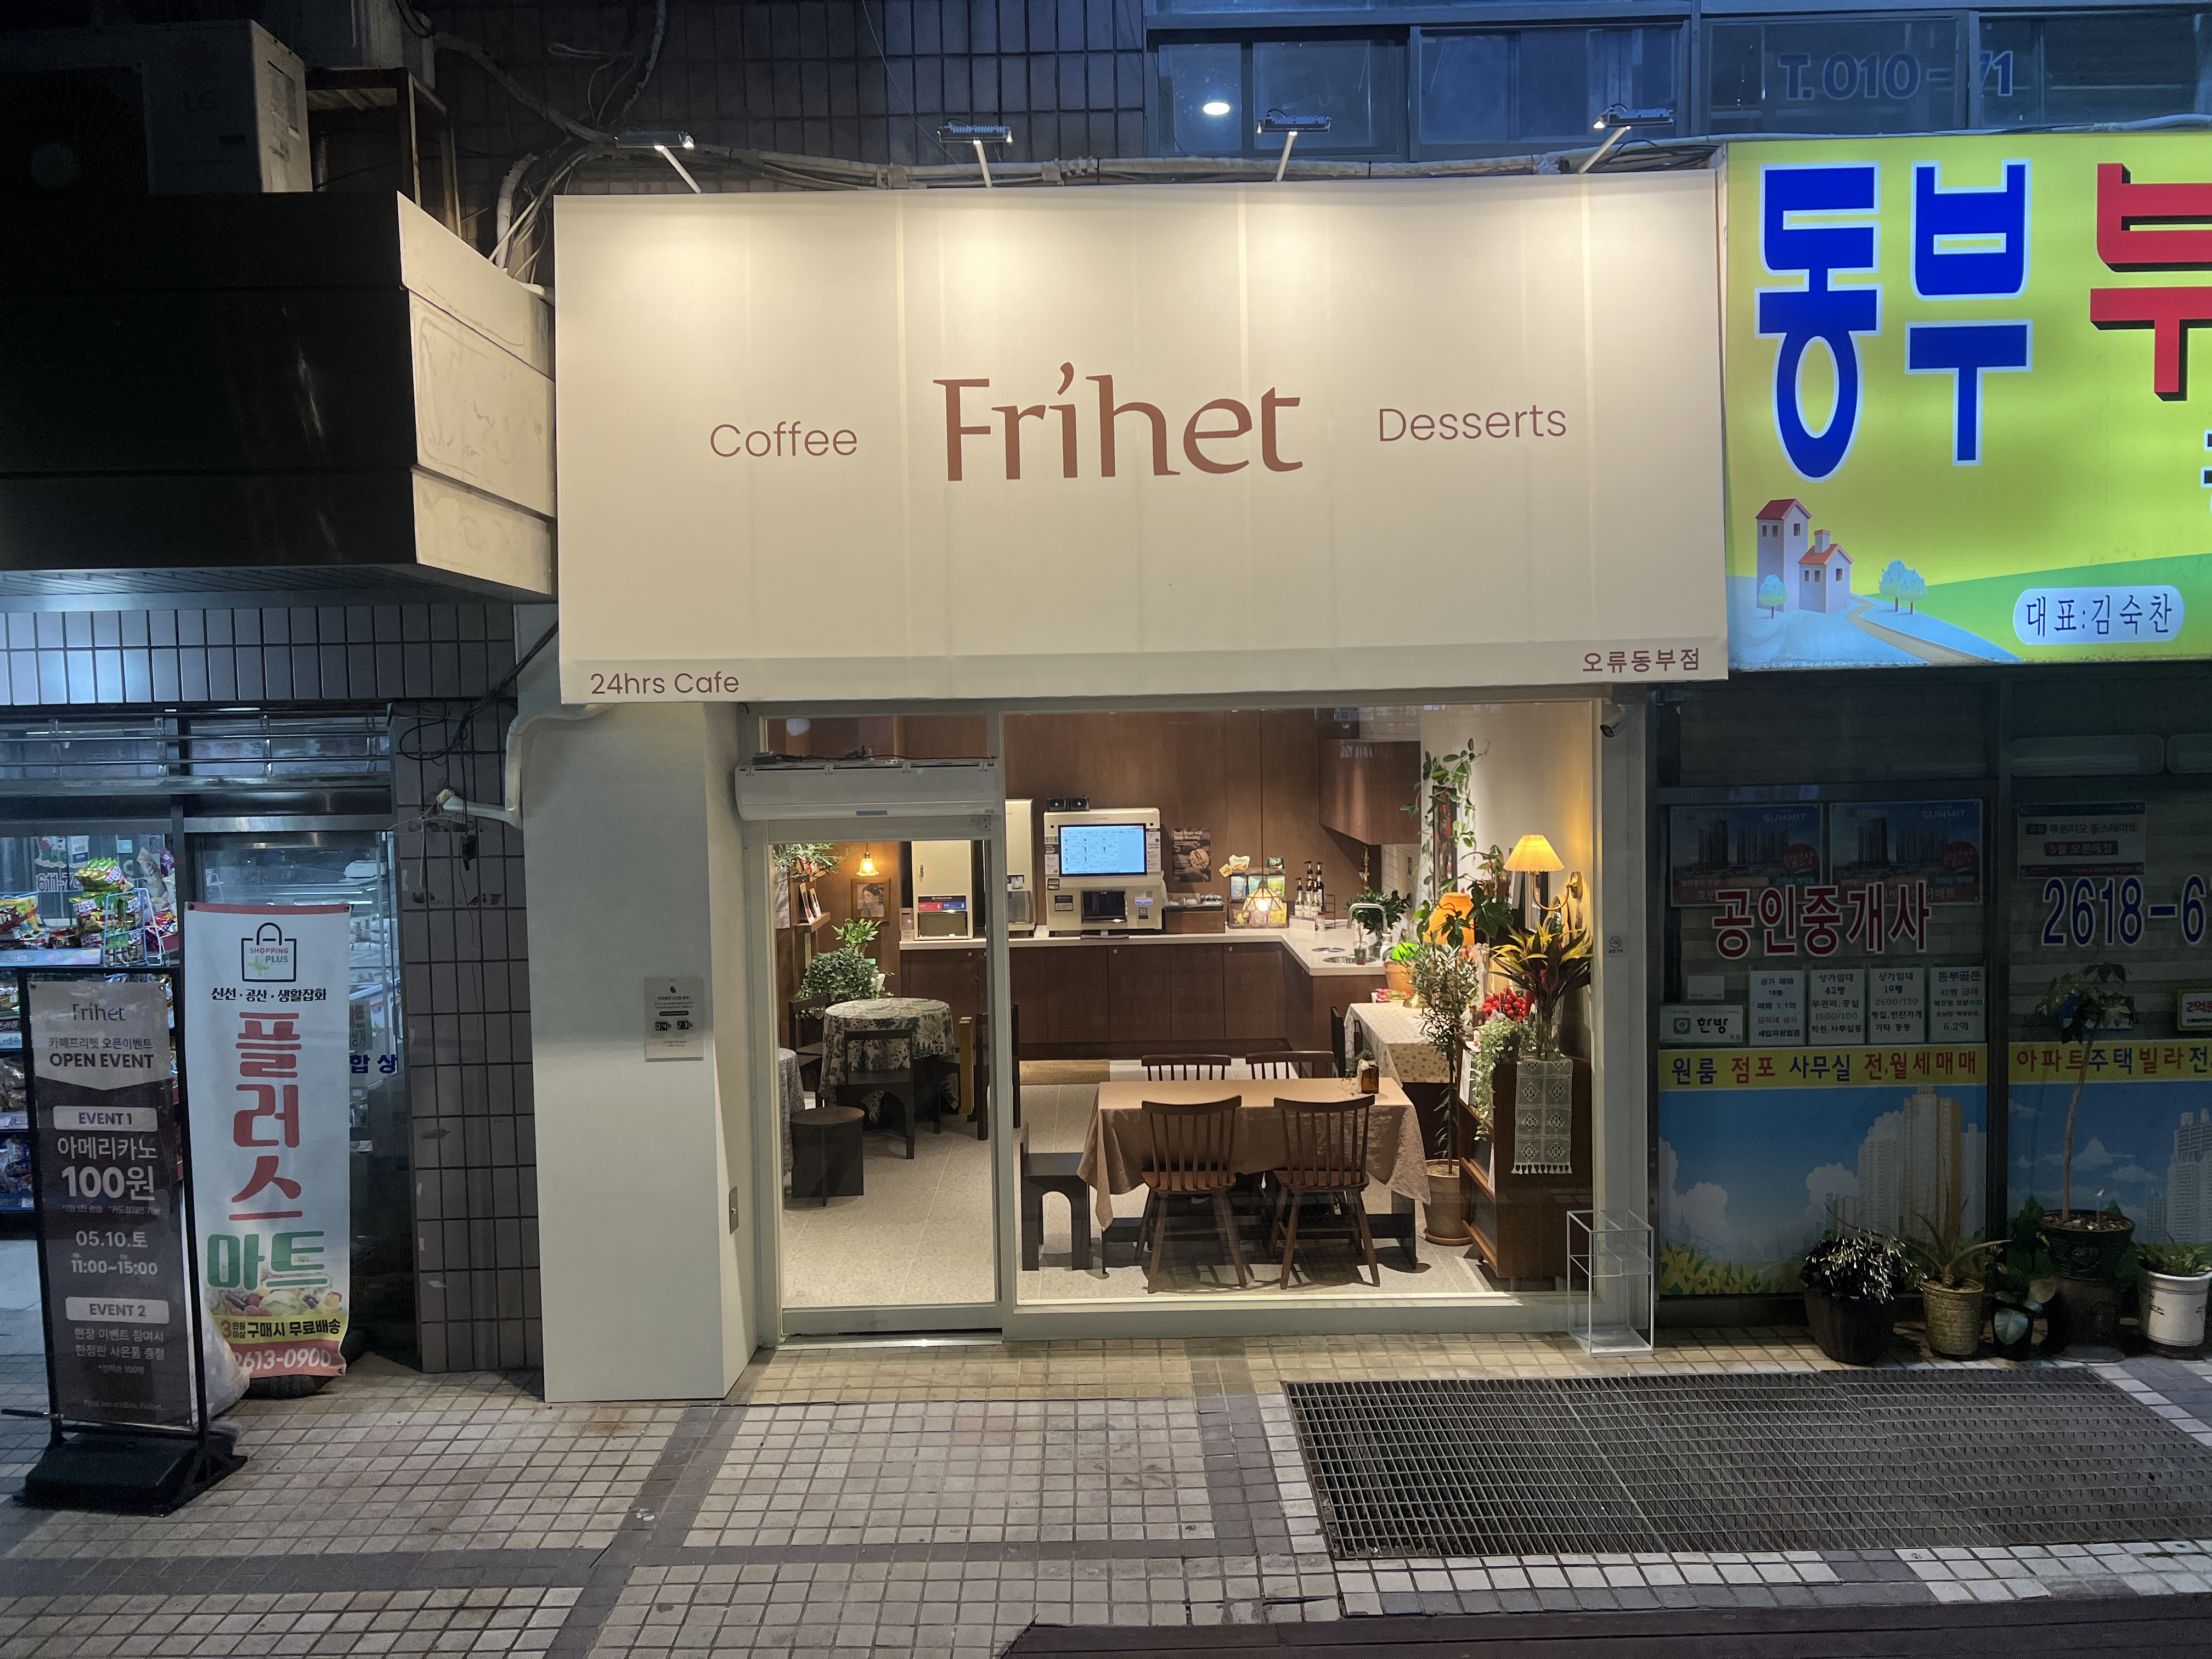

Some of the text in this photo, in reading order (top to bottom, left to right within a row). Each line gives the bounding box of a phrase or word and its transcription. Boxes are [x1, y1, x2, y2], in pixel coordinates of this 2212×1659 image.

[1755, 159, 2034, 482] 동부
[1378, 404, 1567, 442] Desserts
[710, 421, 857, 457] Coffee
[1583, 648, 1699, 673] 오류동부점
[590, 671, 739, 695] 24hrs Cafe
[1712, 879, 1932, 960] 공인중개사
[1819, 973, 1854, 983] 상가임대
[1878, 972, 1914, 981] 상가임대
[211, 988, 326, 1002] 신선 공산 생활잡화
[1825, 986, 1845, 995] 42평
[1884, 985, 1903, 994] 19평
[1815, 1012, 1858, 1020] 1500/100
[1875, 1023, 1892, 1032] 기타
[103, 1037, 154, 1049] 오픈이벤트
[49, 1053, 154, 1068] OPEN EVENT
[1671, 1057, 1718, 1086] 원룸
[1731, 1056, 1776, 1084] 점포
[1790, 1054, 1851, 1082] 사무실
[78, 1112, 132, 1125] EVENT 1
[229, 1012, 302, 1221] 플러스
[57, 1135, 157, 1160] 아메리카노
[61, 1166, 155, 1200] 100원
[76, 1231, 148, 1248] 05.10.토
[71, 1260, 157, 1276] 11:00~15:00
[207, 1231, 328, 1291] 마트
[89, 1304, 146, 1317] EVENT 2
[74, 1328, 163, 1344] 현장 이벤트 참여시
[248, 1322, 285, 1338] 구매시
[290, 1318, 341, 1336] 무료배송
[75, 1345, 164, 1361] 한정판 사은품 증정
